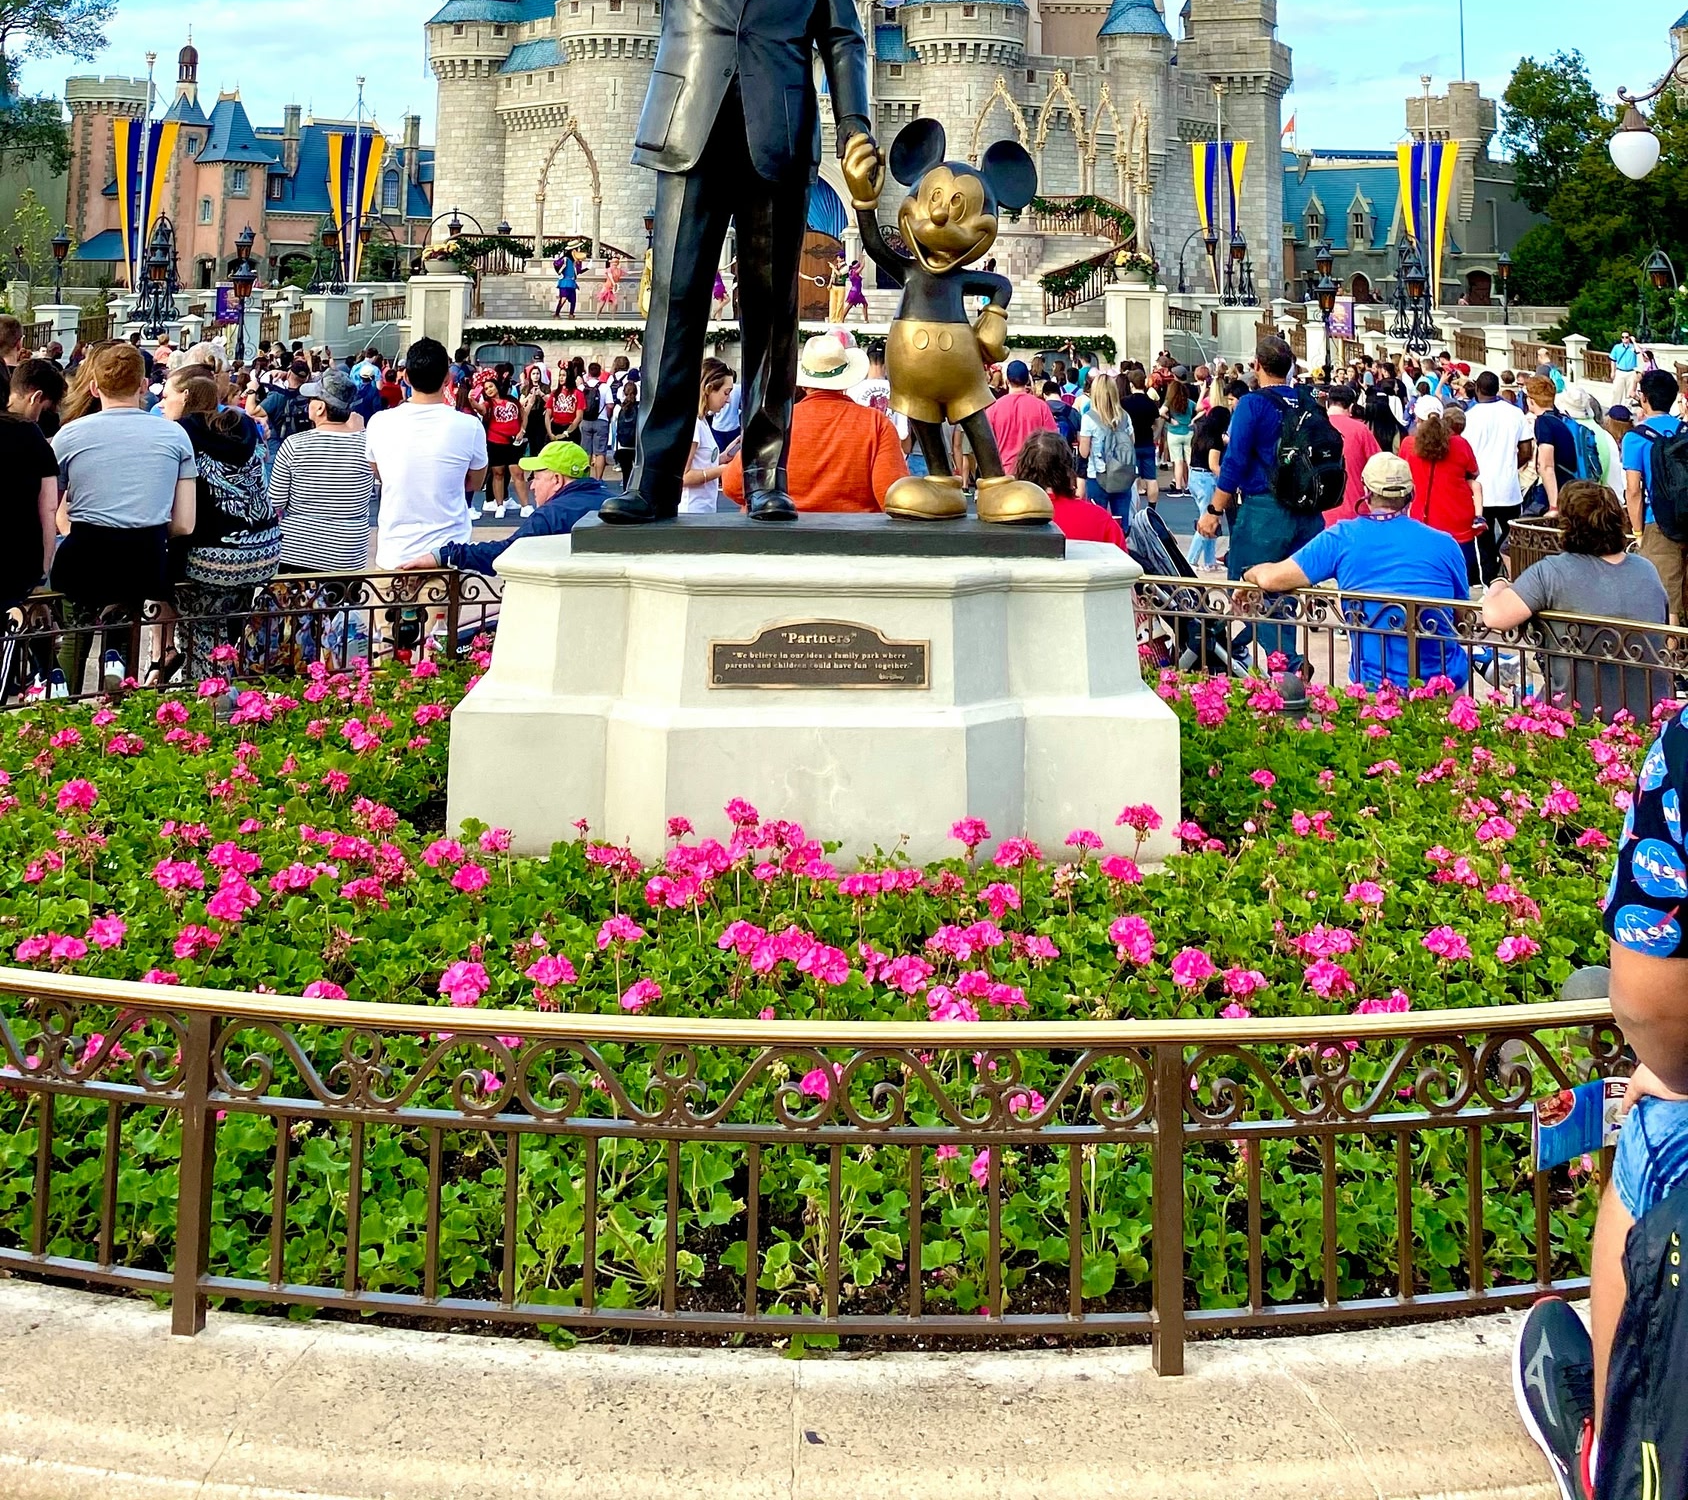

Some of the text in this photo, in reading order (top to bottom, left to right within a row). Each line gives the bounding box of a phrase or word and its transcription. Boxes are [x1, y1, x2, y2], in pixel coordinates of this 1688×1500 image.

[781, 632, 857, 644] "Partners"
[834, 652, 860, 660] family
[862, 652, 879, 660] park
[725, 662, 755, 670] parents
[1617, 924, 1678, 943] NASA
